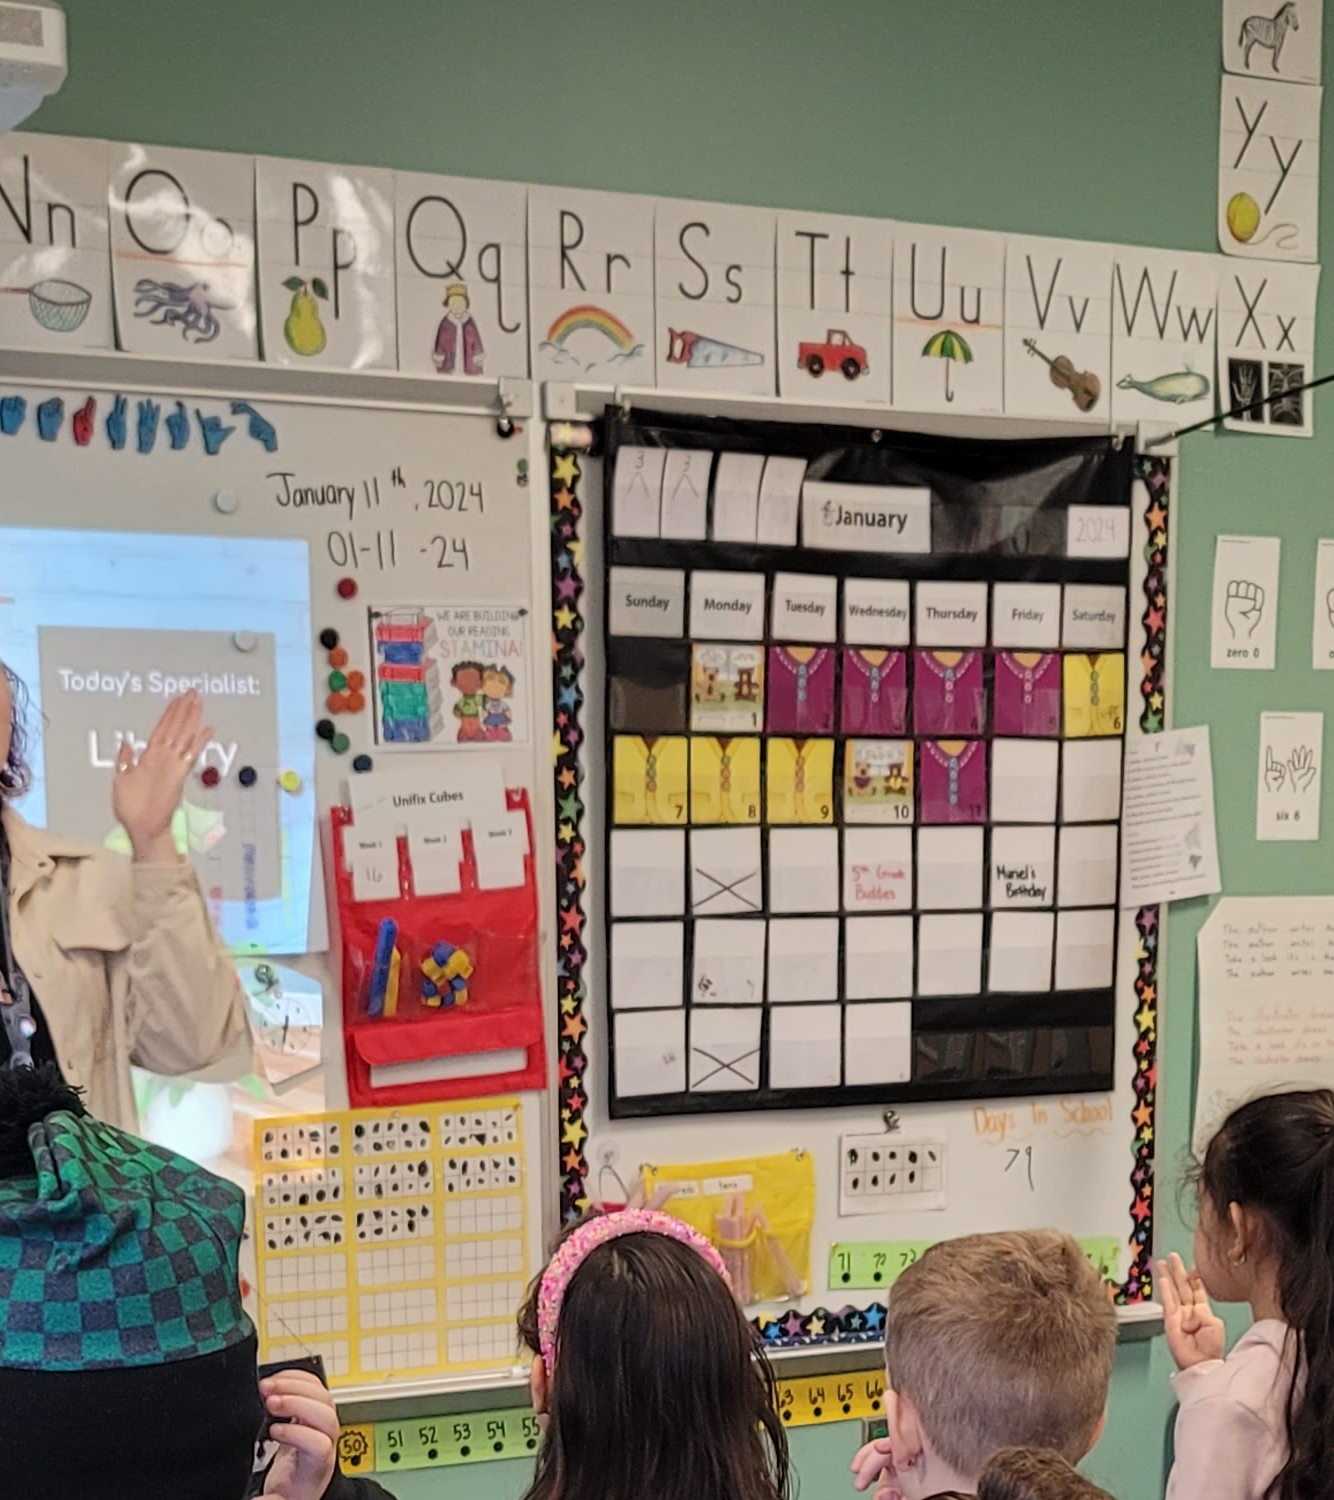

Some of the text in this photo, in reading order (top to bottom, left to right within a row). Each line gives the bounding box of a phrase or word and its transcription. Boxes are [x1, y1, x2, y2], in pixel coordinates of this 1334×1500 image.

[267, 472, 354, 520] January
[836, 508, 908, 534] January
[1076, 515, 1116, 543] 2024
[625, 594, 670, 612] Sunday
[703, 598, 753, 615] Monday
[785, 600, 825, 617] Tuesday
[848, 604, 908, 621] Wednesday
[926, 606, 978, 623] Thursday
[1011, 608, 1044, 624] Friday
[1071, 608, 1116, 624] Saturday
[59, 669, 261, 697] Today's Specialist:
[392, 791, 463, 808] Unifix Cubes
[974, 1107, 1016, 1139] Days
[1061, 1099, 1114, 1128] School
[1004, 1146, 1036, 1193] 79
